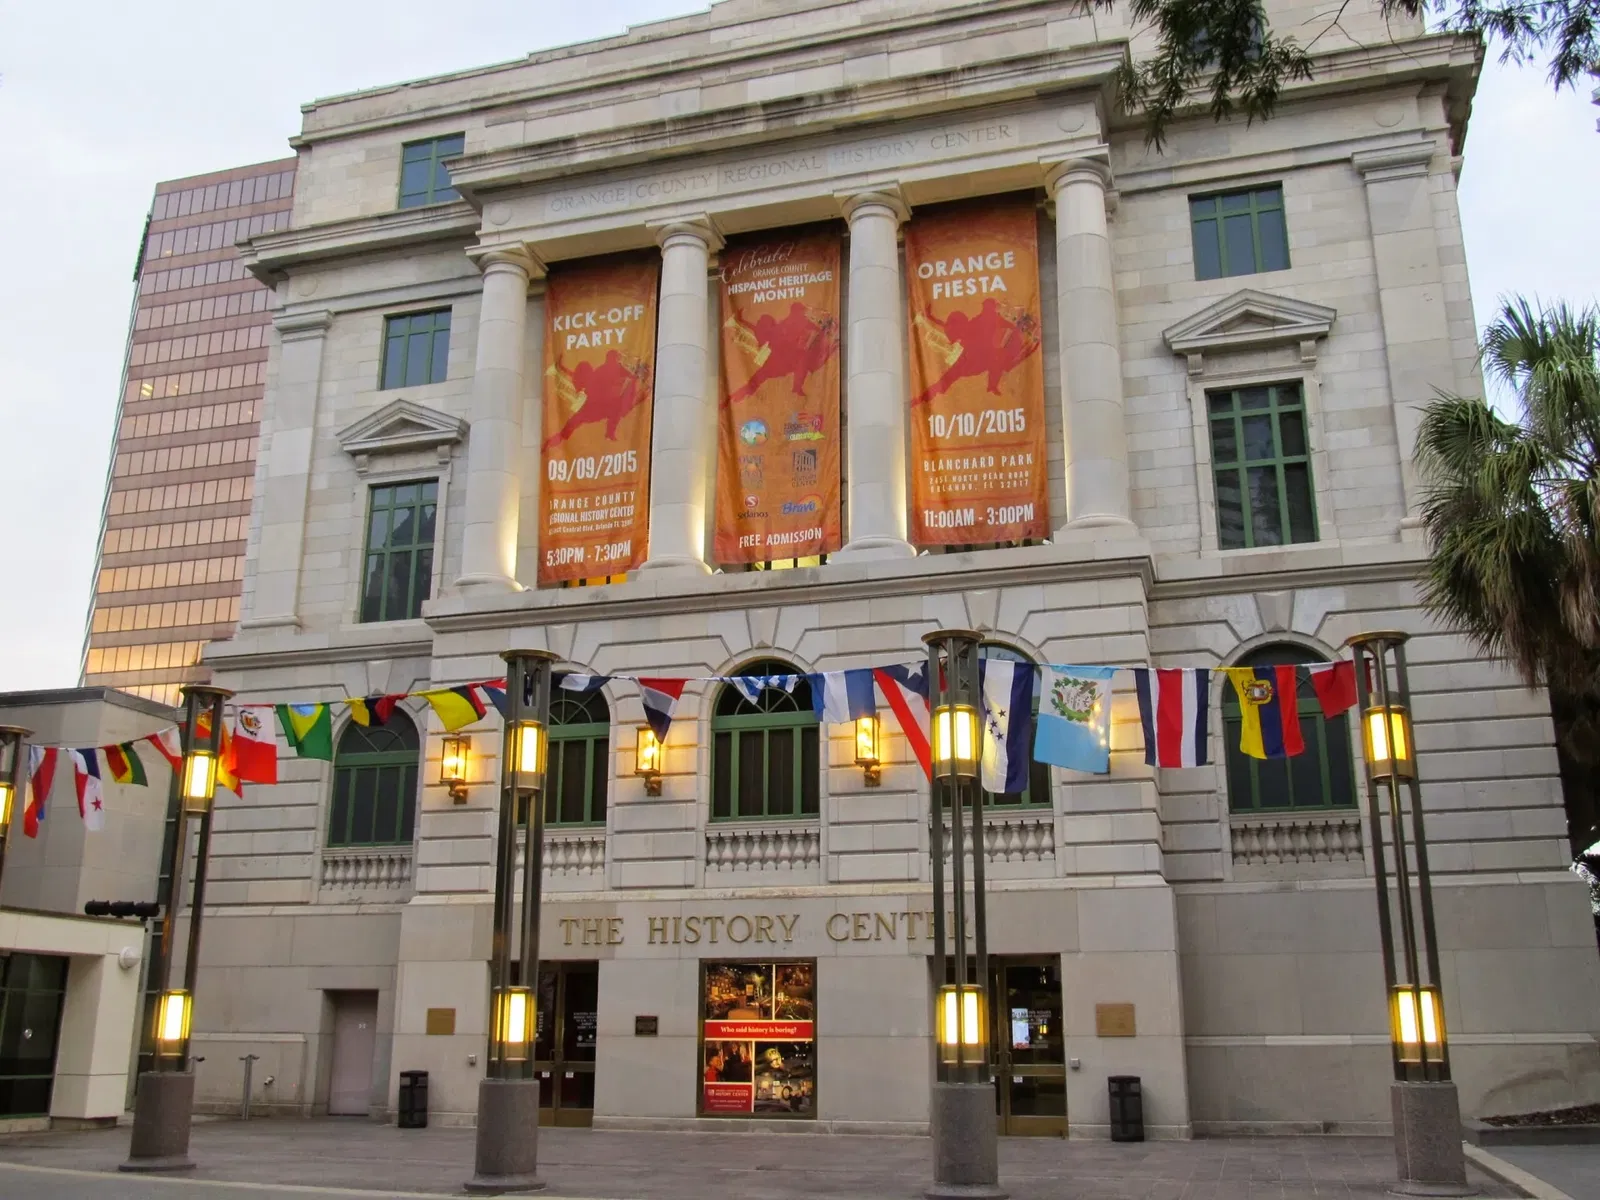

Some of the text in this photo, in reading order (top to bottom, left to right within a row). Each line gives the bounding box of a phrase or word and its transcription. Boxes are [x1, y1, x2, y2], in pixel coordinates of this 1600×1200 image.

[550, 124, 1013, 213] ORANGE COUNTY REGIONAL HISTORY CENTER
[721, 242, 795, 284] Celebrate!
[752, 263, 808, 278] ORANGE COUNTY
[918, 250, 1015, 279] ORANGE
[727, 271, 832, 295] HISPANIC HERITAGE
[753, 286, 805, 304] MONTH
[932, 274, 1007, 300] FIESTA
[553, 304, 645, 332] KICK-OFF
[566, 327, 627, 350] PARTY
[927, 407, 1026, 439] 10/10/2015
[547, 450, 637, 482] 09/09/2015
[923, 453, 1033, 472] BLANCHARD PARK
[952, 474, 978, 483] NORTH
[1008, 470, 1029, 479] ROAD
[983, 481, 994, 489] FL
[595, 491, 635, 507] COUNTY
[580, 509, 608, 522] HISTORY
[609, 505, 635, 518] CENTER
[923, 508, 975, 528] 11:00AM
[986, 502, 1034, 525] 3:00PM
[739, 527, 822, 549] FREE ADMISSION
[546, 547, 585, 567] 5:30PM
[594, 539, 631, 562] 7:30PM
[558, 917, 625, 945] THE
[647, 914, 800, 945] HISTORY
[748, 1026, 769, 1035] history
[775, 1026, 798, 1035] boring?
